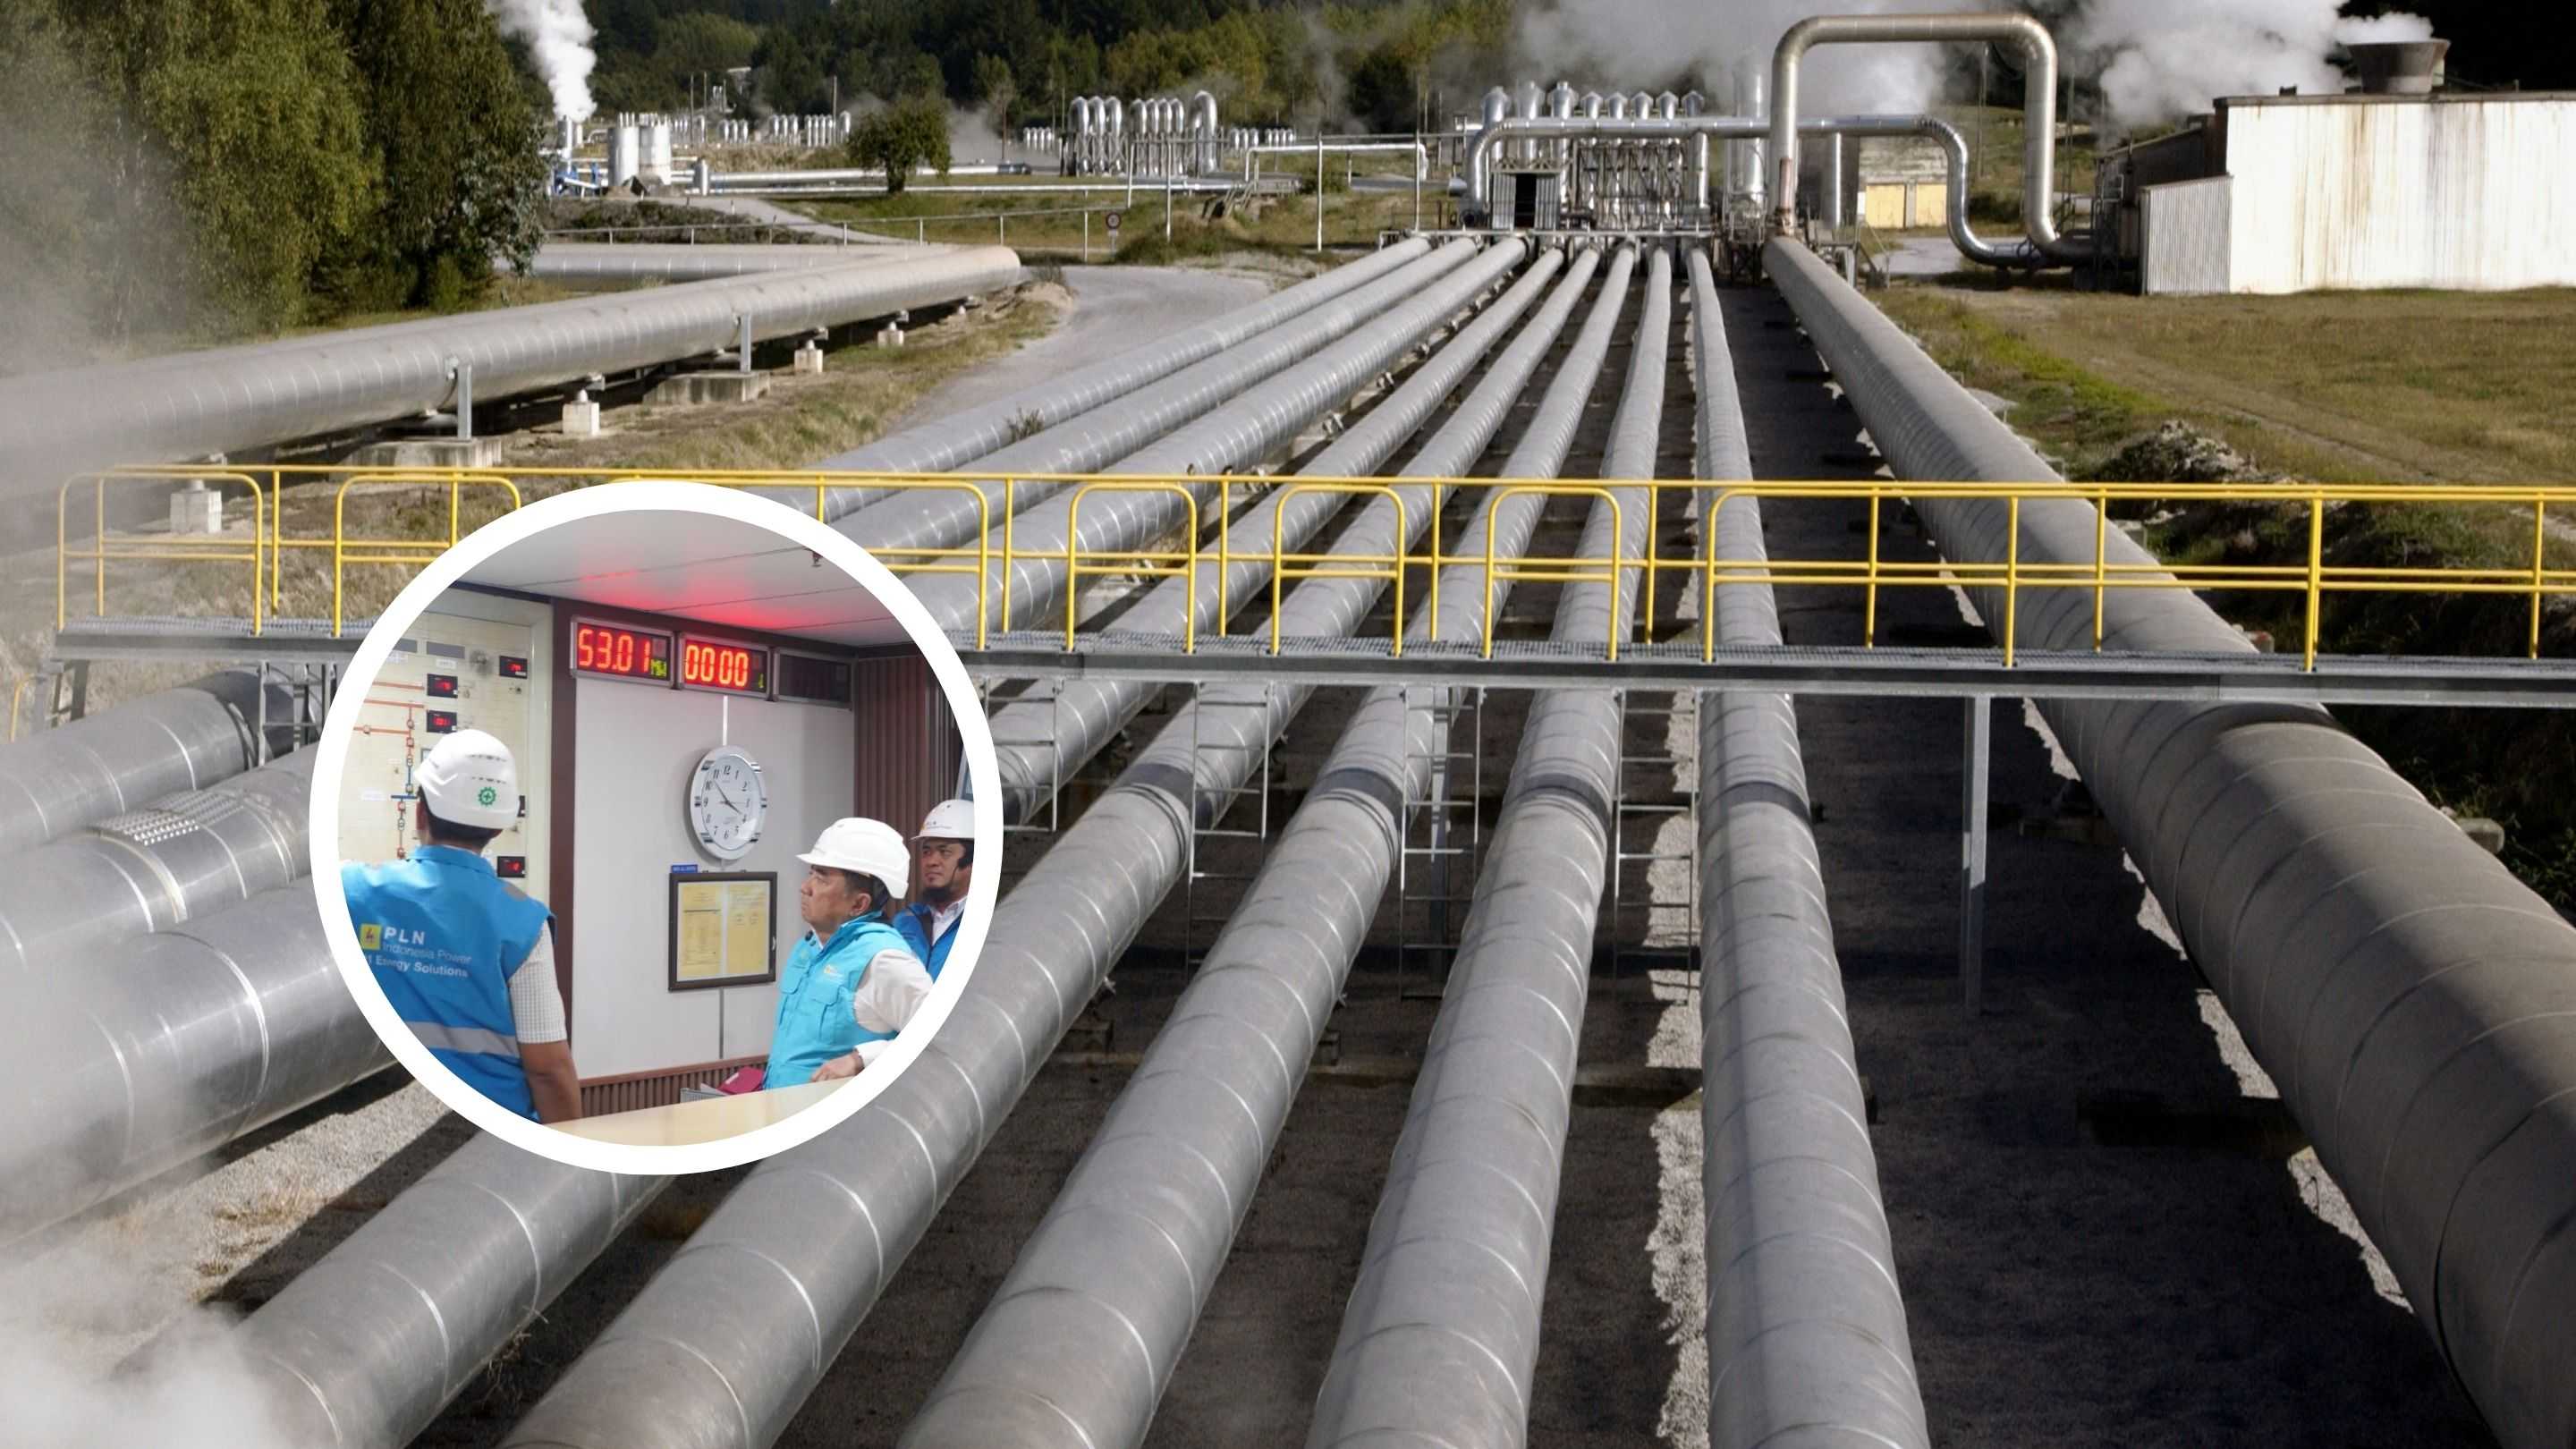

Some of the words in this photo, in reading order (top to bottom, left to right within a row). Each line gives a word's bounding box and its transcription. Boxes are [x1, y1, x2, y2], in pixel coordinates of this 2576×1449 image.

[578, 629, 651, 672] 53.01
[713, 768, 719, 779] 11
[724, 765, 731, 775] 12
[735, 770, 739, 780] 1
[741, 781, 748, 792] 2
[724, 830, 729, 840] 6
[385, 926, 425, 945] PLN
[383, 942, 435, 960] Indonesia
[437, 949, 471, 964] Power
[414, 962, 468, 978] Solutions
